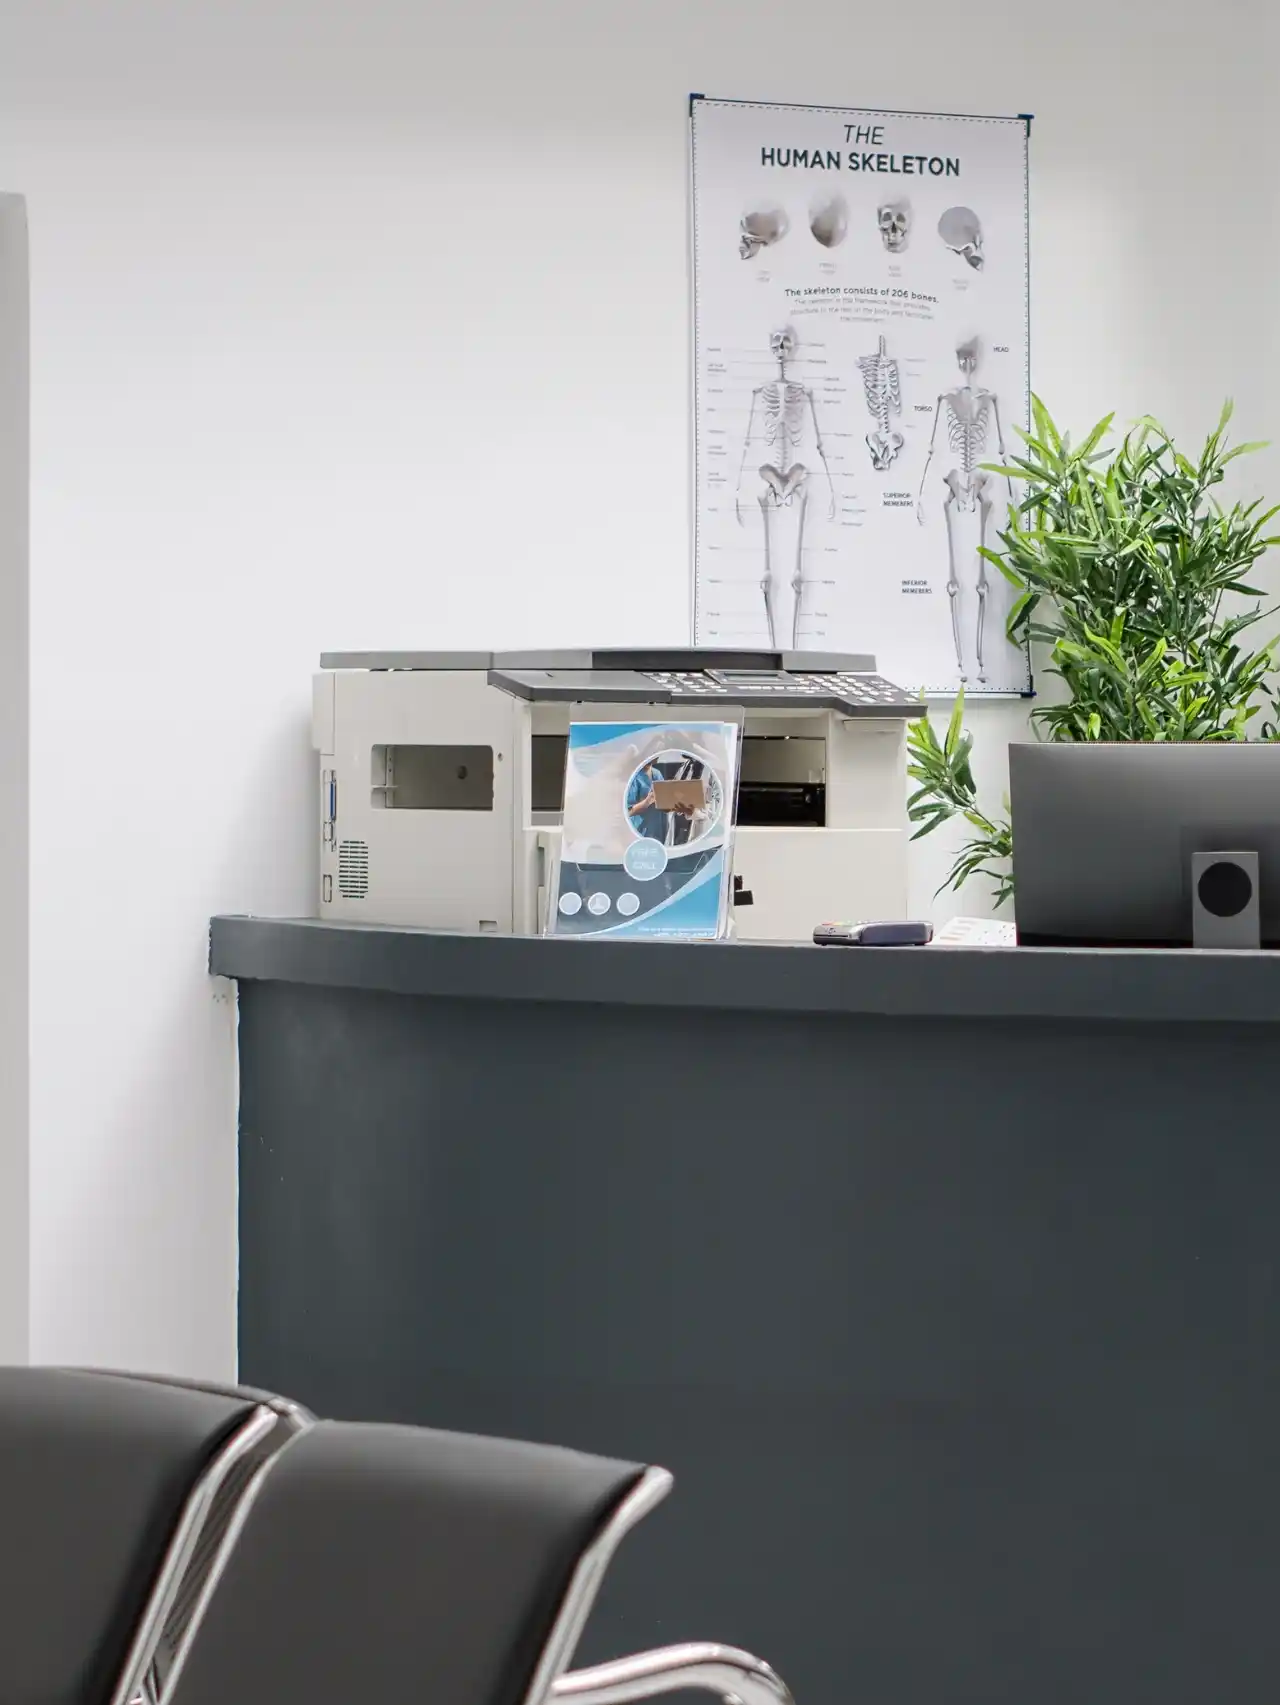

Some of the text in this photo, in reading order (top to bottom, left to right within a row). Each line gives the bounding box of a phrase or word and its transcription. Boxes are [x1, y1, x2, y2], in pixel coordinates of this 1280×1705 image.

[843, 124, 885, 145] THE
[761, 147, 961, 177] HUMAN SKELETON
[785, 288, 801, 297] The
[804, 287, 841, 296] skeleton
[843, 287, 878, 296] consists
[881, 287, 890, 296] of
[891, 289, 909, 298] 206
[911, 291, 940, 304] bones.
